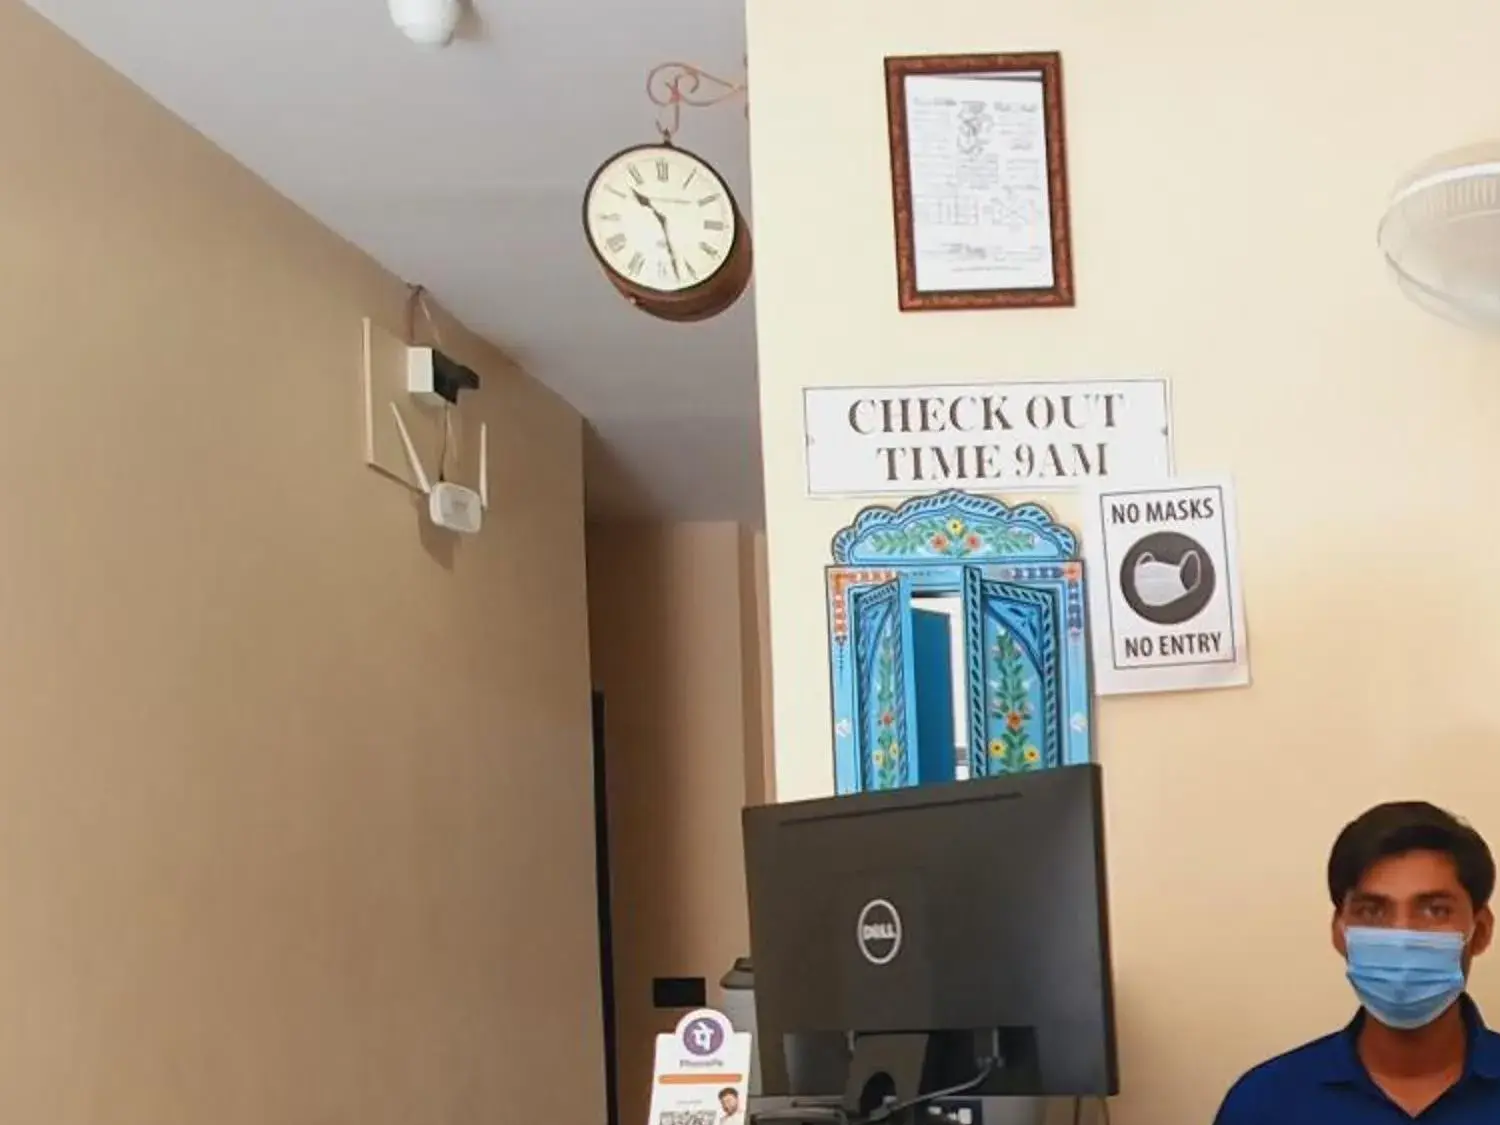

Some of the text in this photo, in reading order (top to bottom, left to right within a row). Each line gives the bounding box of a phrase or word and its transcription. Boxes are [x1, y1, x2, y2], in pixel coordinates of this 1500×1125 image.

[847, 392, 1125, 435] CHECK OUT
[875, 442, 1110, 482] TIME 9AM
[1111, 497, 1215, 525] NO MASKS
[1124, 632, 1223, 659] NO ENTRY
[864, 922, 897, 941] DELL
